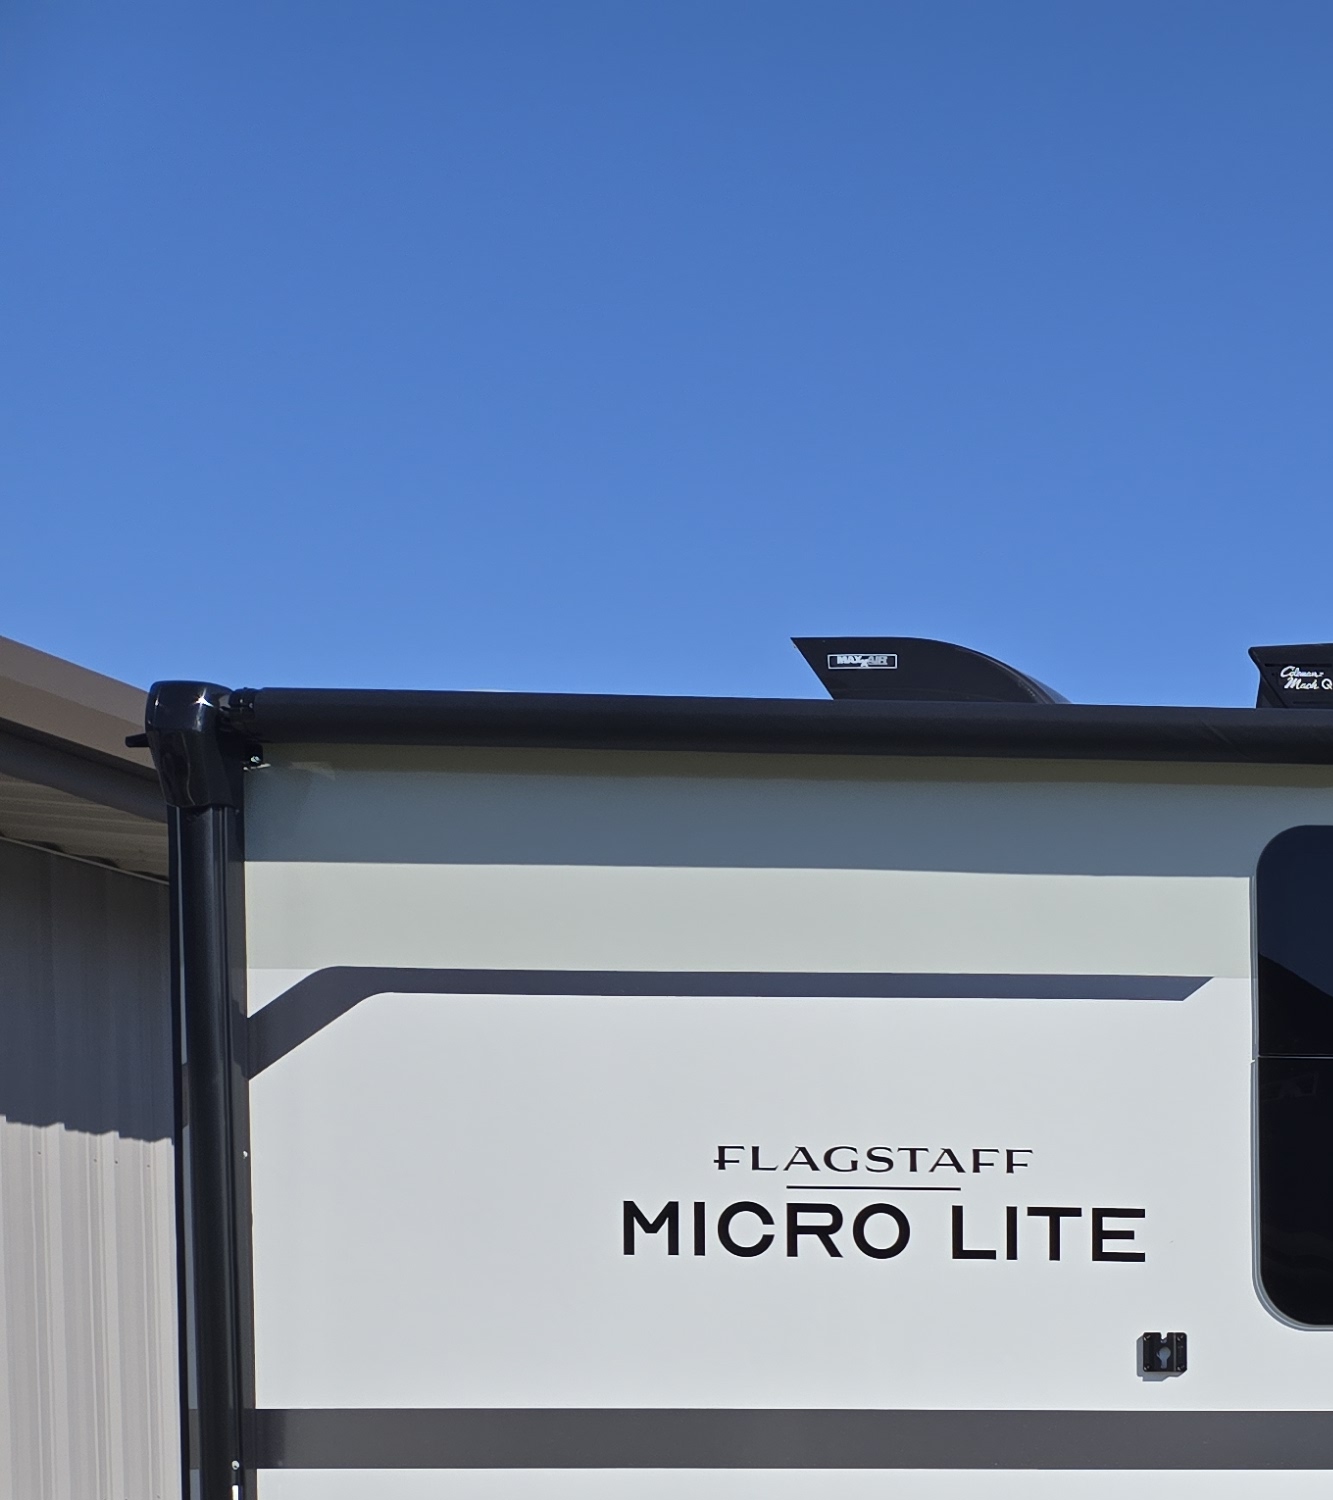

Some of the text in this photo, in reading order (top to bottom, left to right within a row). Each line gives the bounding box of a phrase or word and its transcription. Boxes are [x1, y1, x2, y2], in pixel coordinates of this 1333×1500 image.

[1284, 676, 1333, 690] Mach Q
[714, 1145, 1033, 1174] FLAGSTAFF
[622, 1200, 1146, 1262] MICRO LITE
